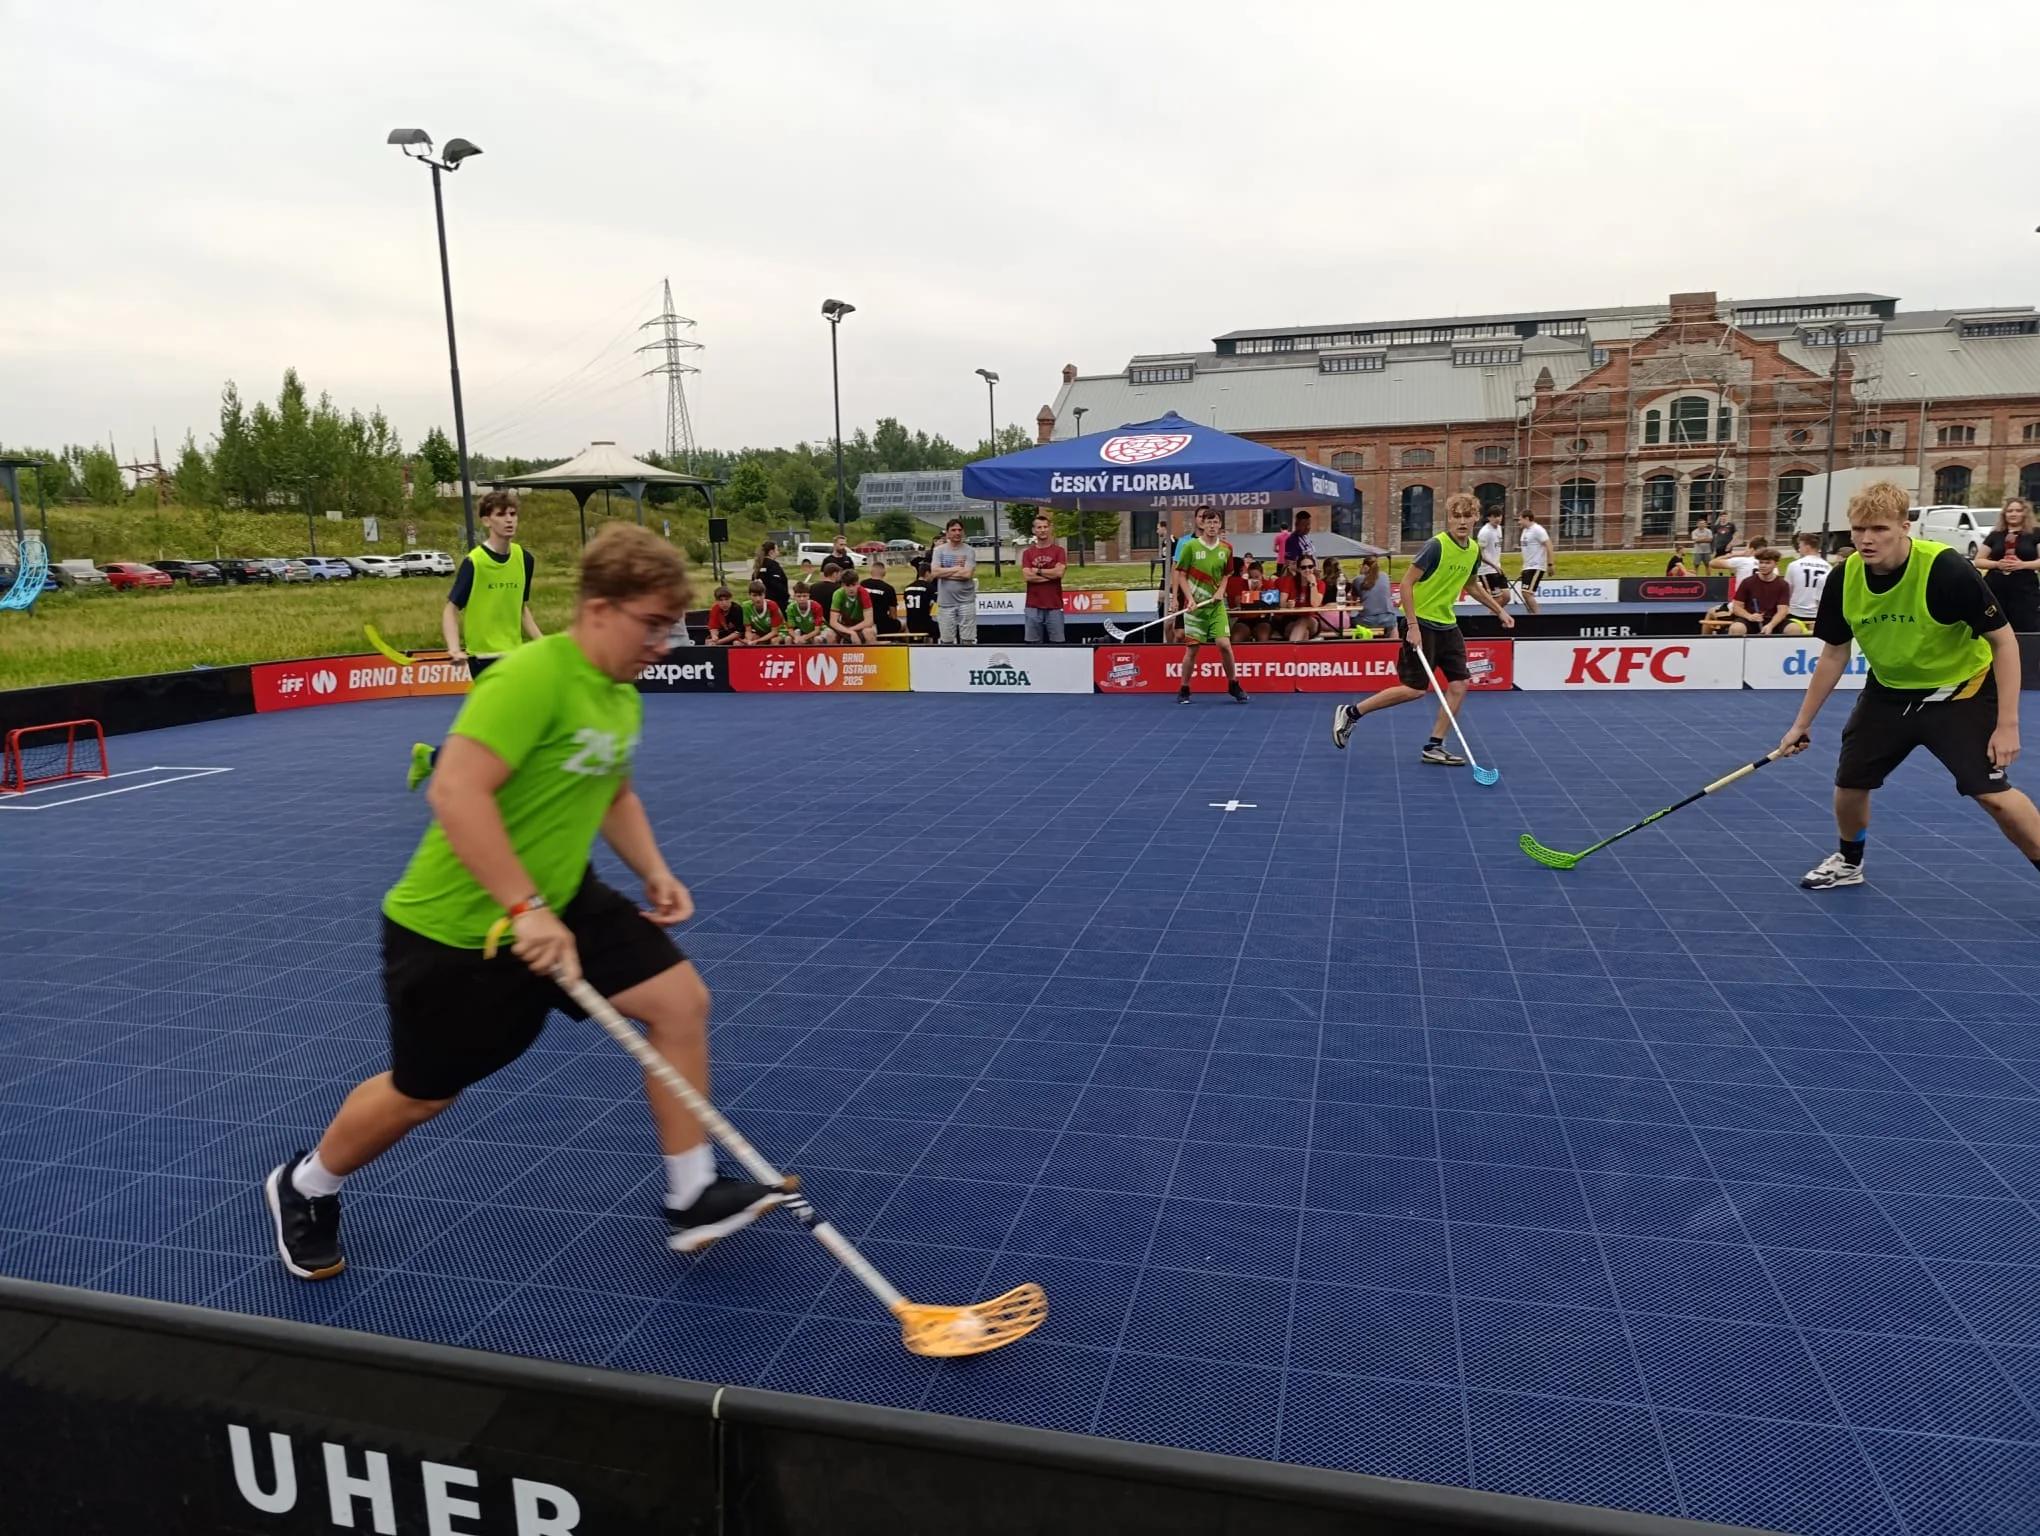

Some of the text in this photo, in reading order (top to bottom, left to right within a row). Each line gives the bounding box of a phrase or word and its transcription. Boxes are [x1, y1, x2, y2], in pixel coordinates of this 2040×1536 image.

[1051, 471, 1194, 493] ČESKÝ FLORBAL
[906, 595, 921, 609] 31
[1861, 613, 1916, 625] KIPSTA
[842, 652, 865, 664] BRNO
[1565, 646, 1690, 684] KFC
[349, 666, 397, 689] BRNO
[401, 664, 414, 684] &
[842, 664, 878, 675] OSTRAVA
[1200, 662, 1262, 678] STEET
[1265, 661, 1363, 678] FLOORBALL
[842, 675, 864, 686] 2025
[969, 670, 1032, 686] HOLBA
